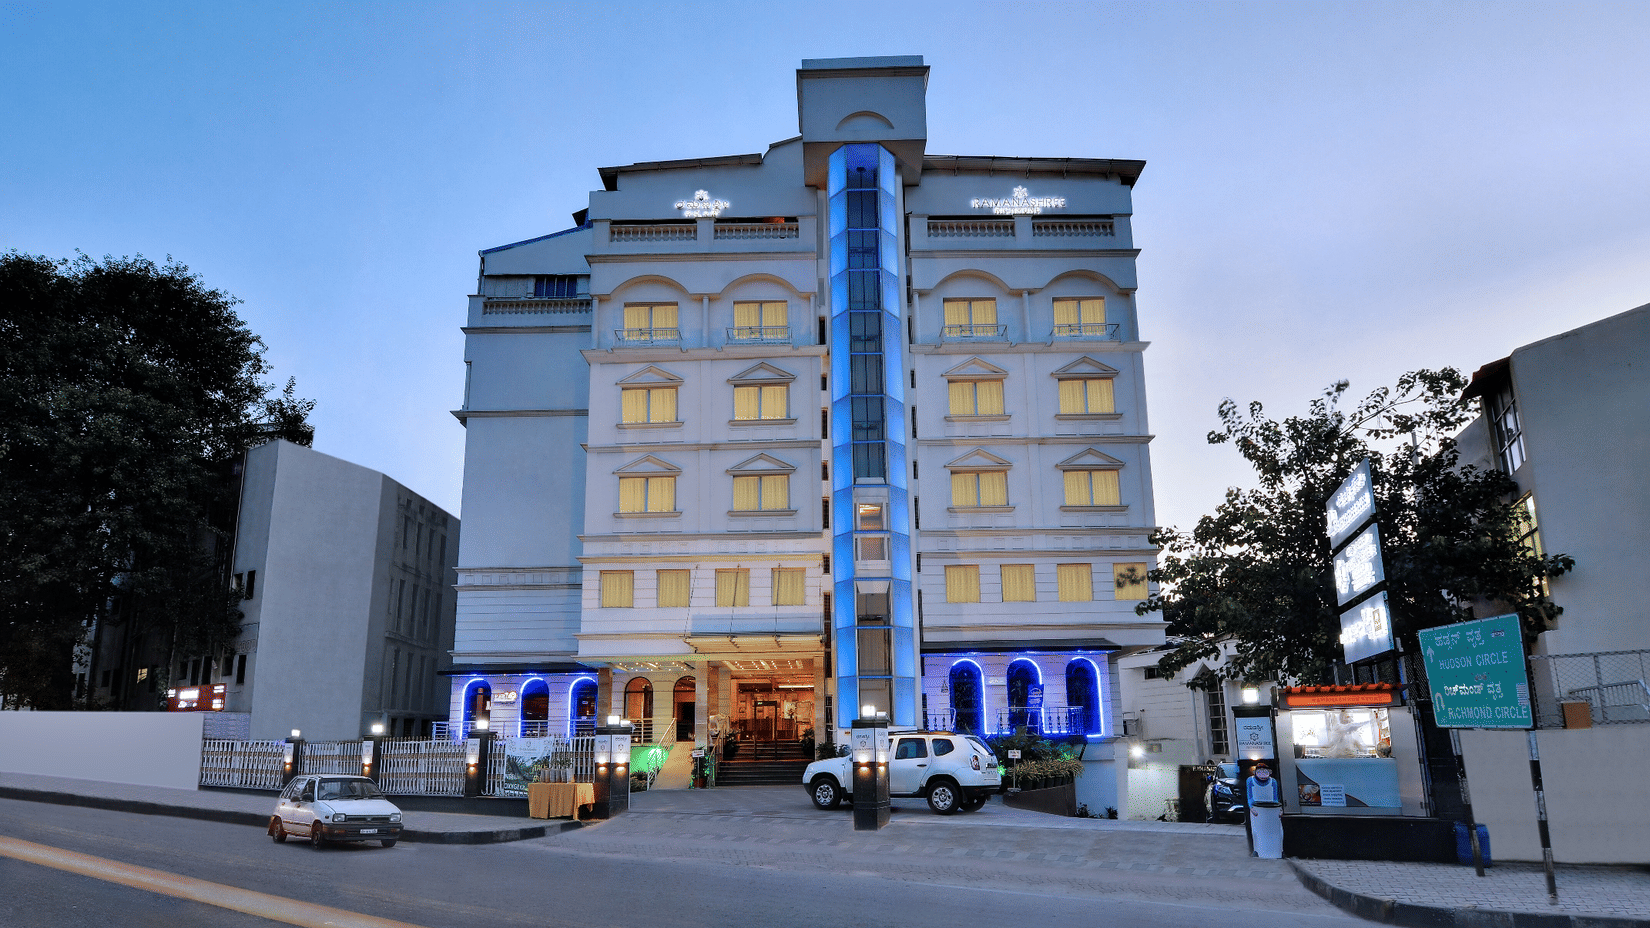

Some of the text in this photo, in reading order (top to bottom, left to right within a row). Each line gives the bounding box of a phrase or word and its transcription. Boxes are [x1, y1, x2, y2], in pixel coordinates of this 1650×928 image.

[972, 197, 1066, 209] RAMANASHREE
[1439, 651, 1508, 670] HUDSON CIRCLE
[1448, 705, 1529, 720] RICHMOND CIRCLE
